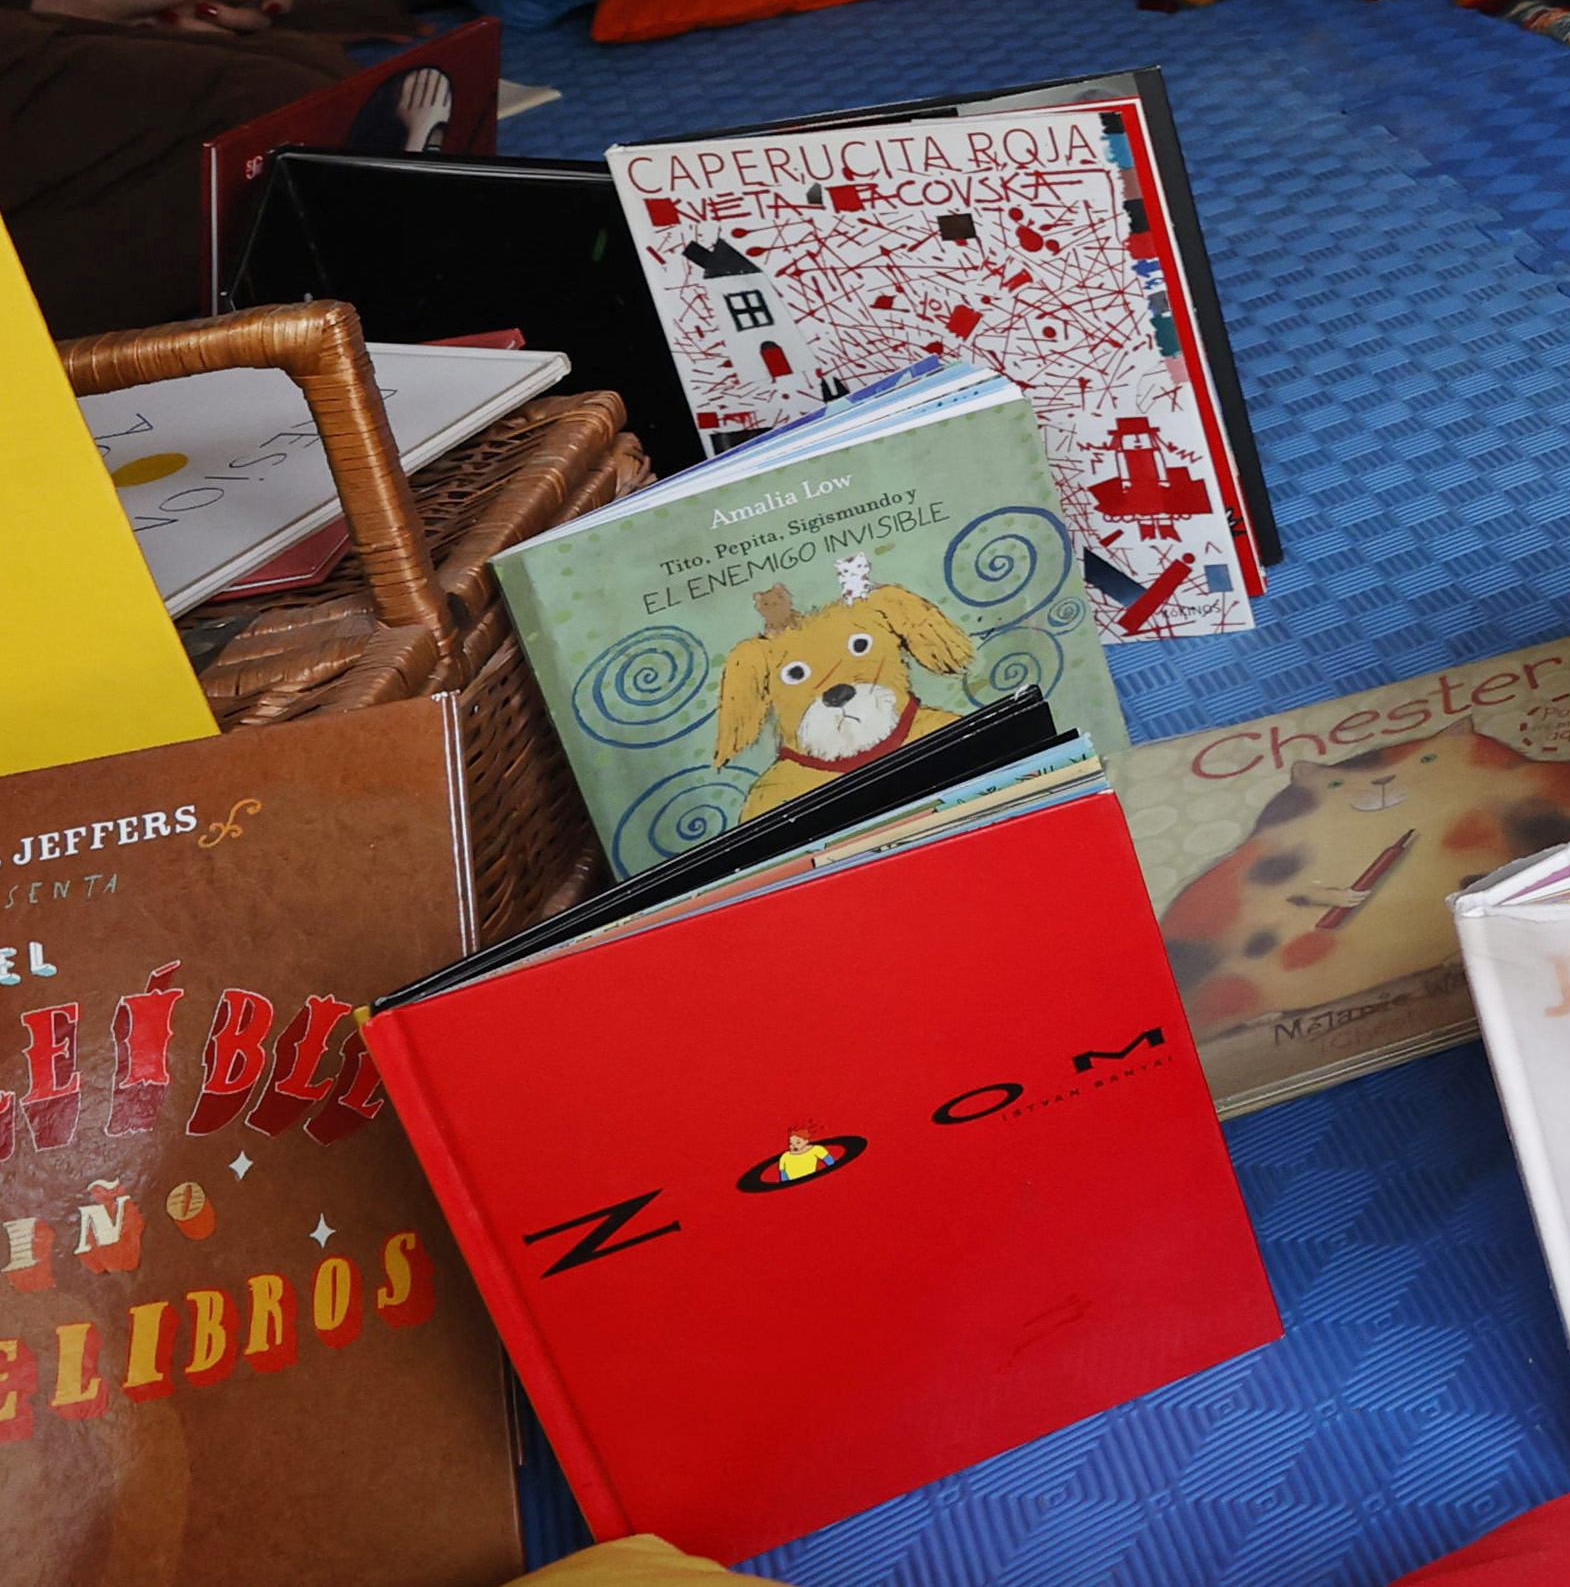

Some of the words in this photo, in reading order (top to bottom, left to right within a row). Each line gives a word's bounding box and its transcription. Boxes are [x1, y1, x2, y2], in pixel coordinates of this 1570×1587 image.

[627, 135, 955, 195] CAPERUCITA
[967, 123, 1099, 170] ROJA
[709, 489, 800, 530] Amalia
[801, 473, 853, 501] Low
[786, 491, 903, 535] Sigismundo
[903, 486, 918, 504] y
[643, 588, 682, 615] EL
[687, 541, 818, 601] ENEMIGO
[823, 500, 951, 554] INVISIBLE
[1191, 656, 1563, 781] Chester
[12, 803, 199, 867] JEFFERS
[1002, 1087, 1081, 1122] ISTVAN
[1093, 1055, 1174, 1089] BANYAI
